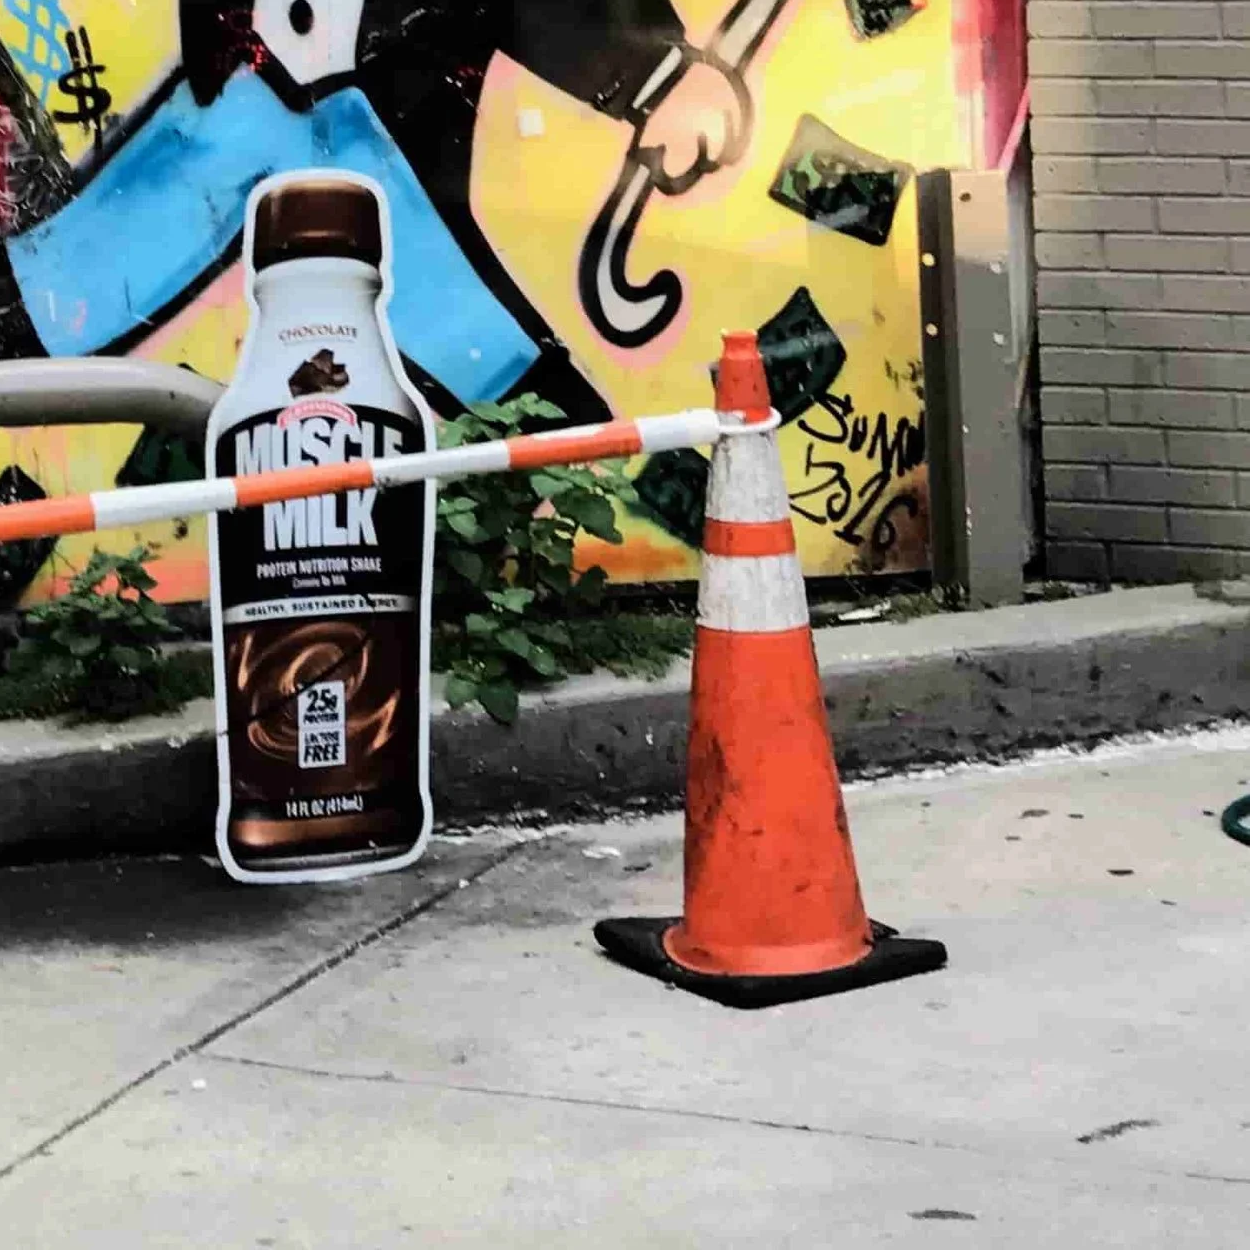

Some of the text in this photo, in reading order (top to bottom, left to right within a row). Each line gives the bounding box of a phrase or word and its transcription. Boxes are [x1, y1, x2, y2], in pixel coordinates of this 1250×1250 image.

[278, 324, 359, 342] CHOCOLATE
[263, 486, 379, 552] MILK
[256, 555, 382, 579] PROTEIN NUTRITION SHAKE
[303, 743, 340, 764] FREE
